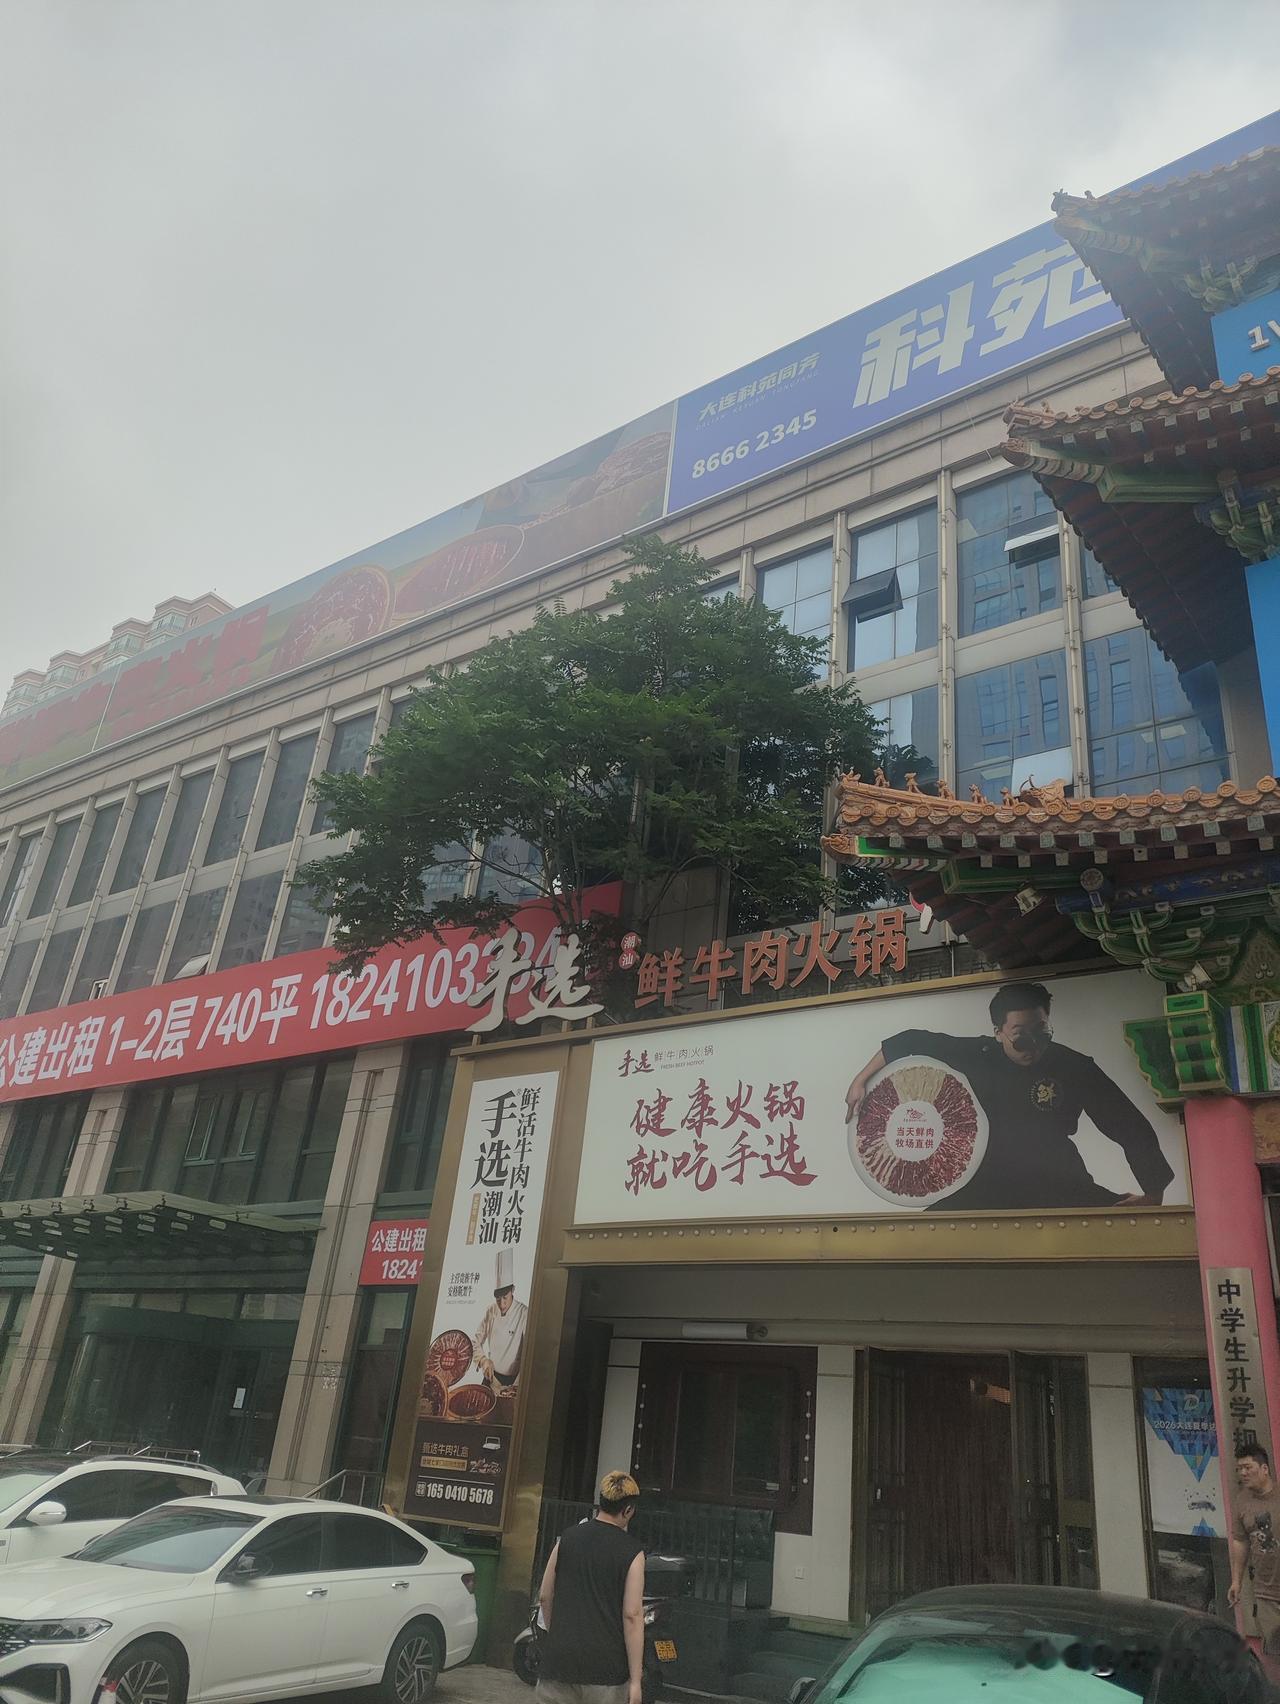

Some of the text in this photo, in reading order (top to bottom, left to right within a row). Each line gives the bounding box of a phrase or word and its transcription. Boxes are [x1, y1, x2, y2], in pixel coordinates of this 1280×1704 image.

[853, 240, 1111, 408] 科苑
[692, 408, 817, 478] 8666 2345
[622, 934, 637, 967] 潮汕
[634, 909, 908, 1008] 鲜牛肉火锅
[196, 973, 303, 1051] 740平
[618, 1049, 655, 1077] 手选
[630, 1078, 806, 1139] 健康火锅
[896, 1126, 935, 1137] 当天鲜肉
[469, 1090, 517, 1190] 手选
[502, 1086, 542, 1245] 鲜活牛肉火锅
[625, 1121, 818, 1196] 就吃手选
[895, 1138, 934, 1148] 牧场直供
[371, 1227, 428, 1252] 公建出租
[478, 1191, 503, 1245] 潮汕
[382, 1259, 424, 1279] 1824
[427, 1483, 444, 1498] 165
[444, 1485, 468, 1501] 0410
[469, 1488, 494, 1505] 5678
